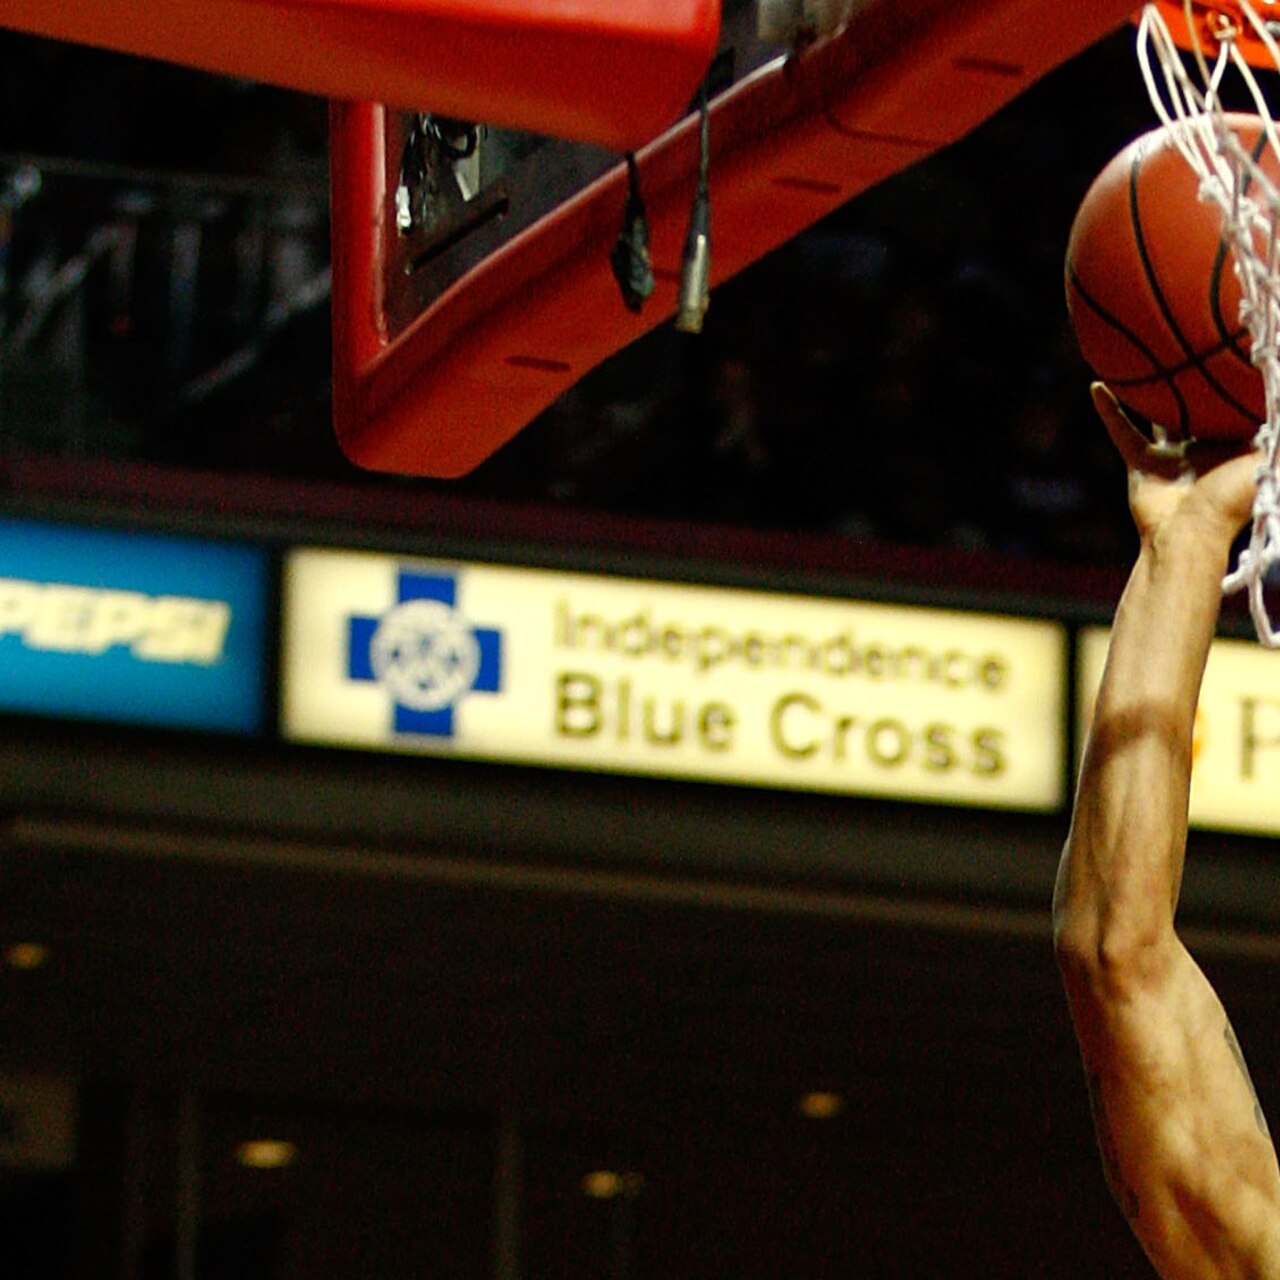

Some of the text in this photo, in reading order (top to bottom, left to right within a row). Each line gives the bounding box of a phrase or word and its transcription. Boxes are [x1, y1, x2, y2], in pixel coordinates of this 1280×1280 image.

[554, 598, 1007, 690] Independence
[556, 672, 1008, 780] Blue Cross
